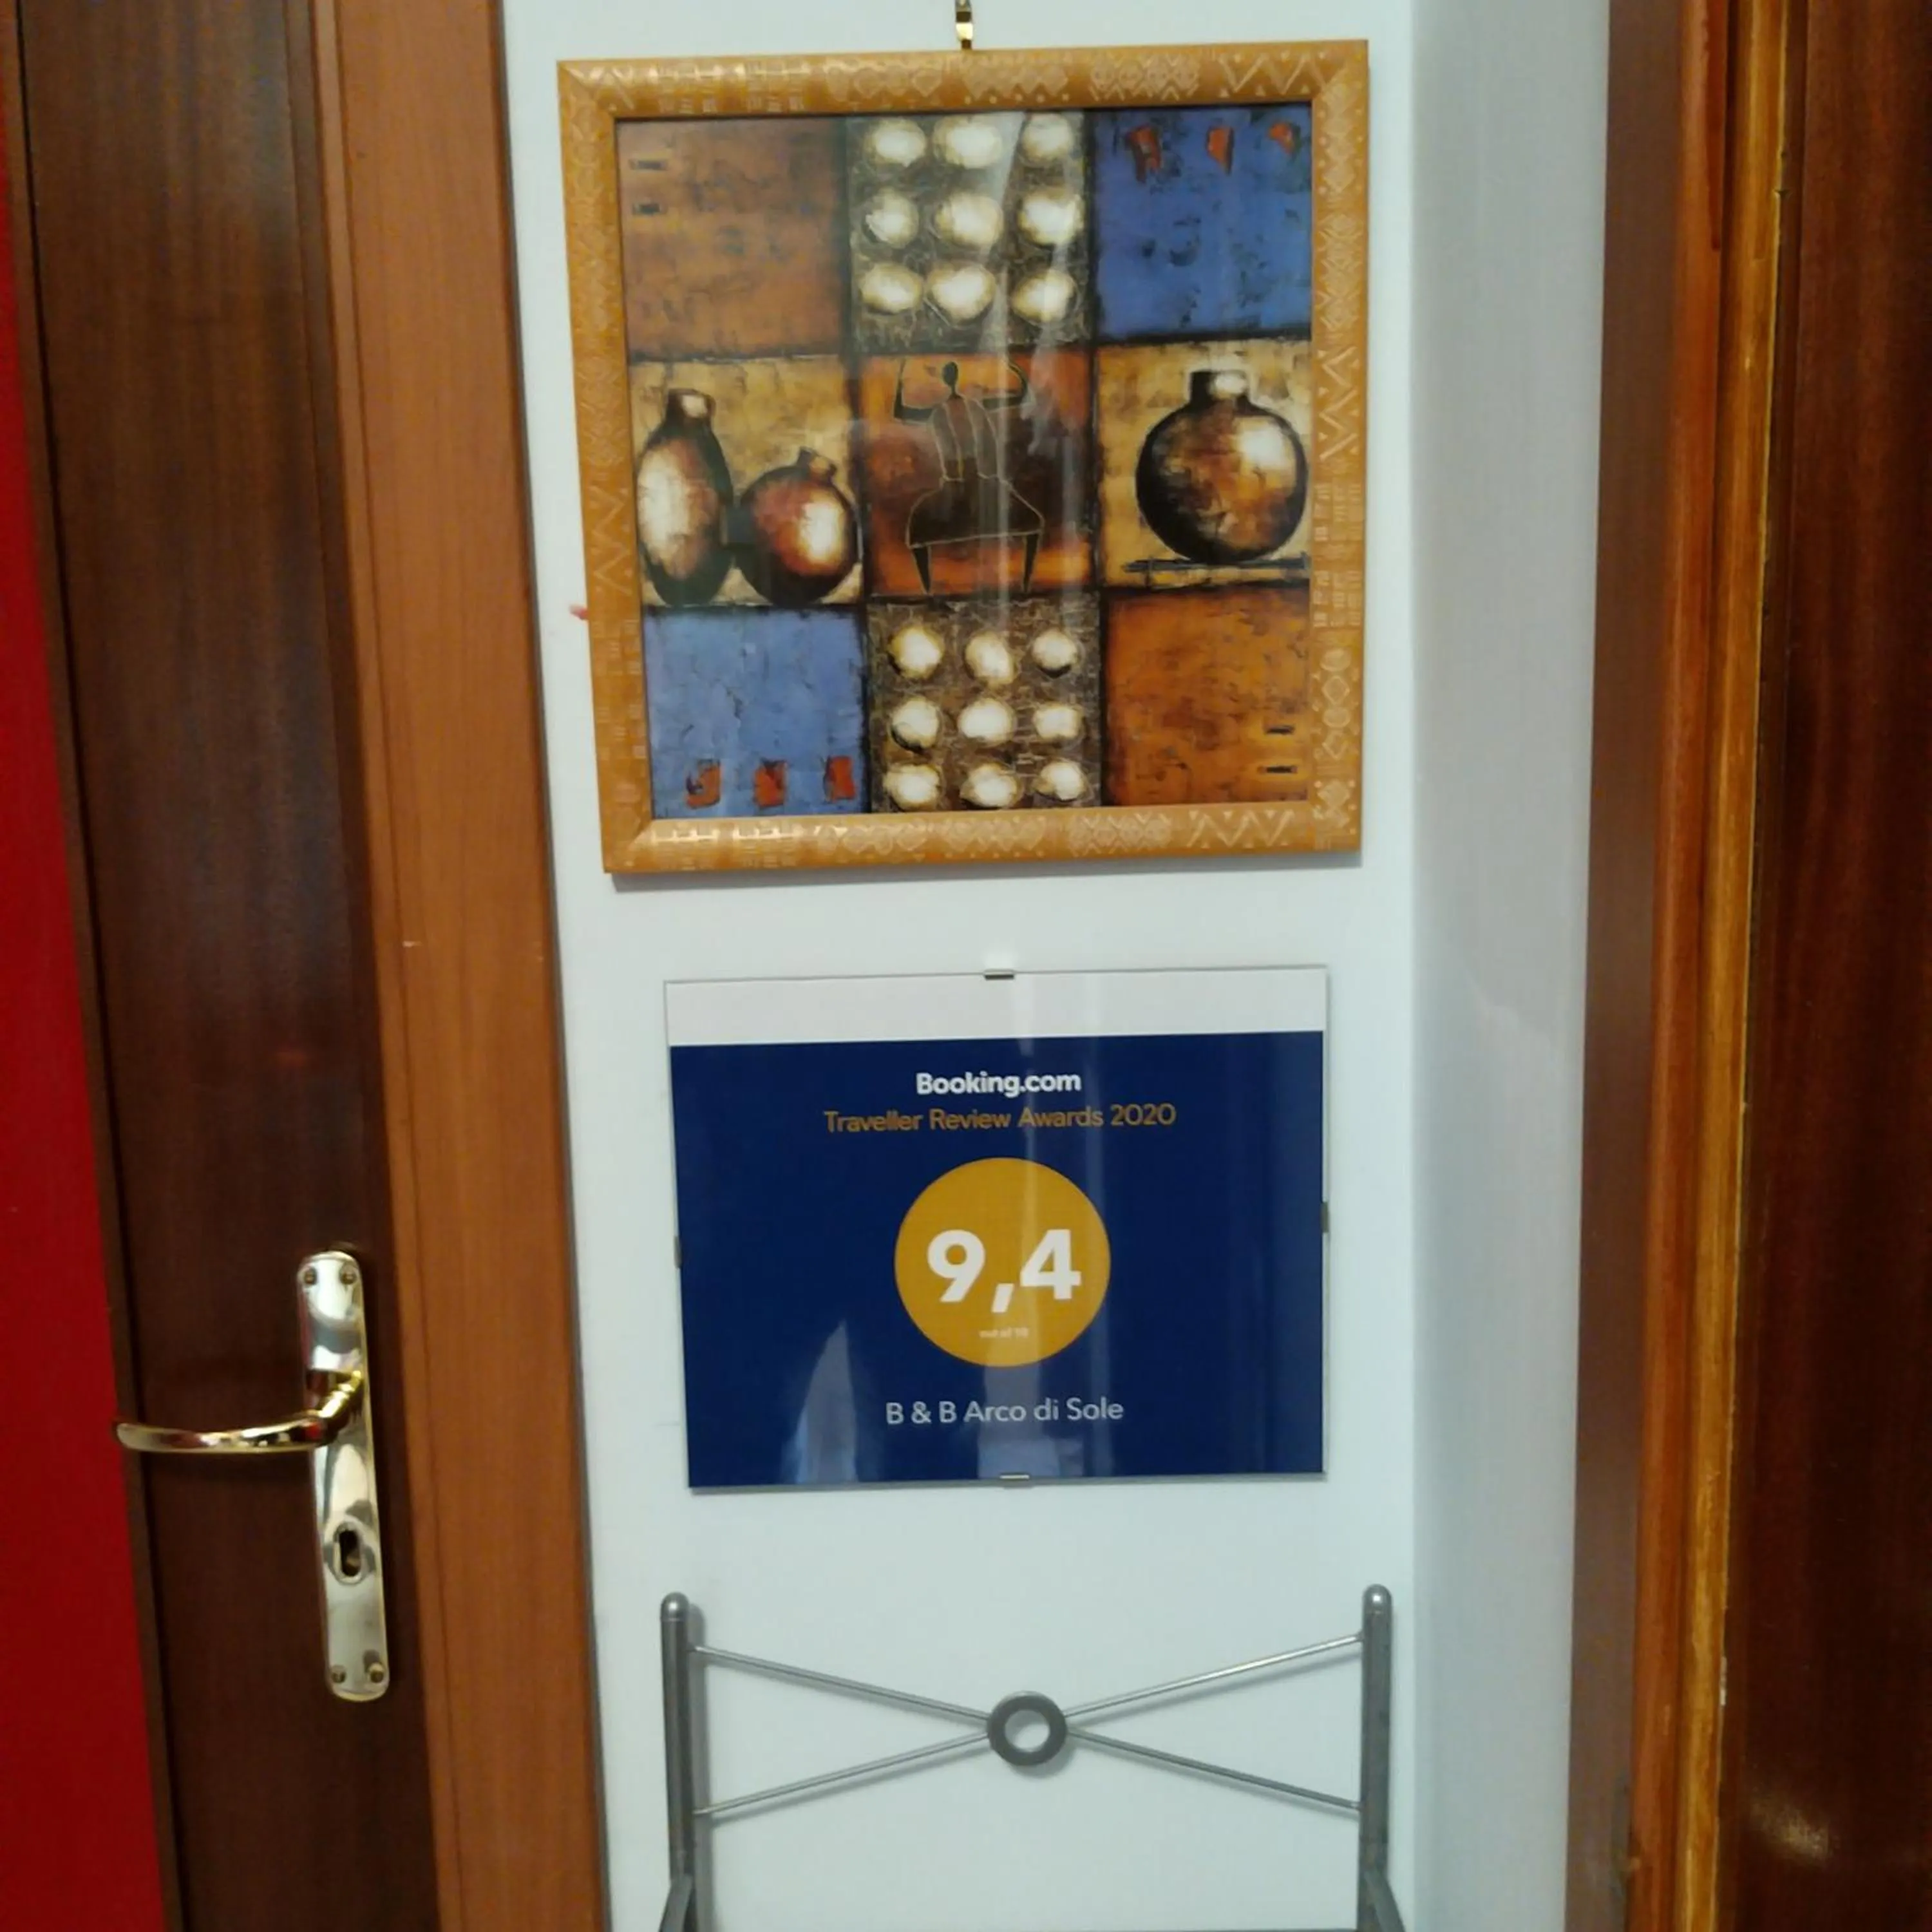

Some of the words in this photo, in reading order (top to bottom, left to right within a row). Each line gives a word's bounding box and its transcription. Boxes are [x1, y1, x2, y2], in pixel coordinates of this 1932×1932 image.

[916, 1071, 1082, 1098] Booking.com
[824, 1110, 923, 1132] Traveller
[929, 1108, 1011, 1130] Review
[1018, 1106, 1104, 1128] Awards
[1111, 1103, 1177, 1126] 2020
[927, 1229, 1082, 1313] 9,4
[886, 1401, 904, 1425] B
[911, 1401, 932, 1424] &
[938, 1401, 957, 1423] B
[963, 1401, 1027, 1423] Arco
[1034, 1397, 1059, 1421] di
[1066, 1396, 1124, 1421] Sole
